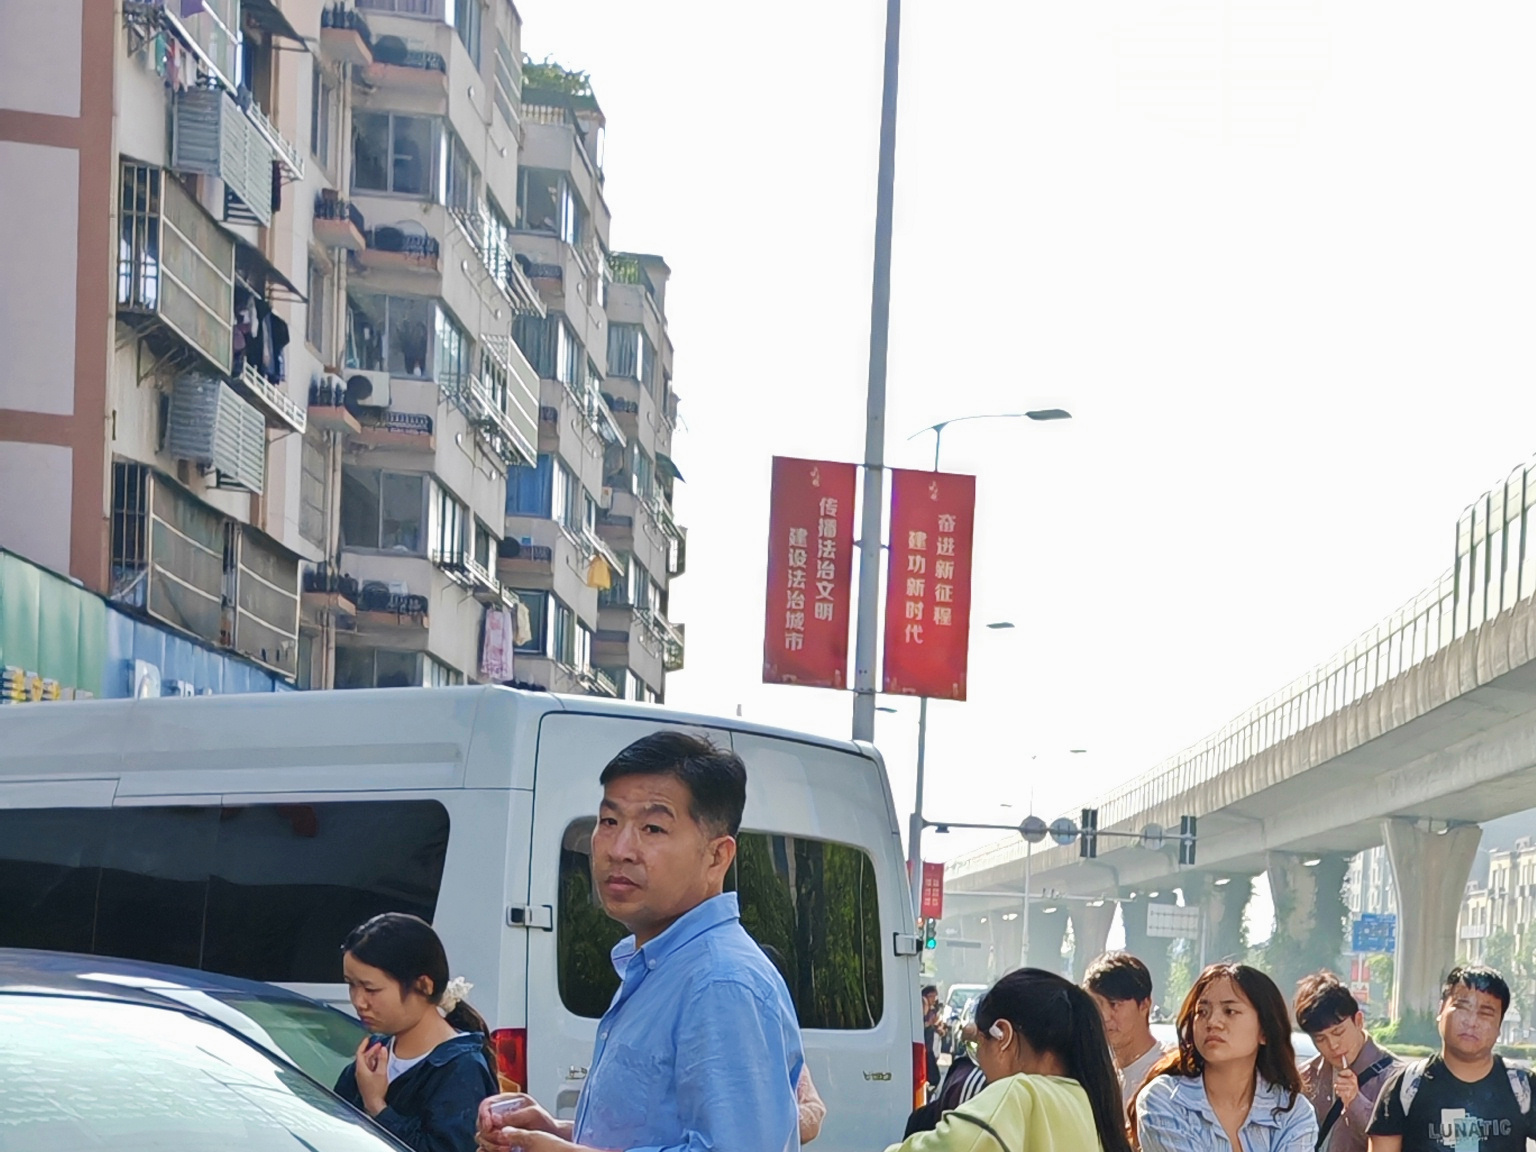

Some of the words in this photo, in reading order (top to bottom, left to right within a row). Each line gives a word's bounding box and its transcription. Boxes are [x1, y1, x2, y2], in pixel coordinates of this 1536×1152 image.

[785, 527, 808, 651] 建设法治城市
[814, 497, 838, 621] 传播法治文明
[904, 531, 927, 644] 建功新时代
[933, 514, 956, 626] 奋进新征程
[1428, 1118, 1512, 1139] LUNATIC
